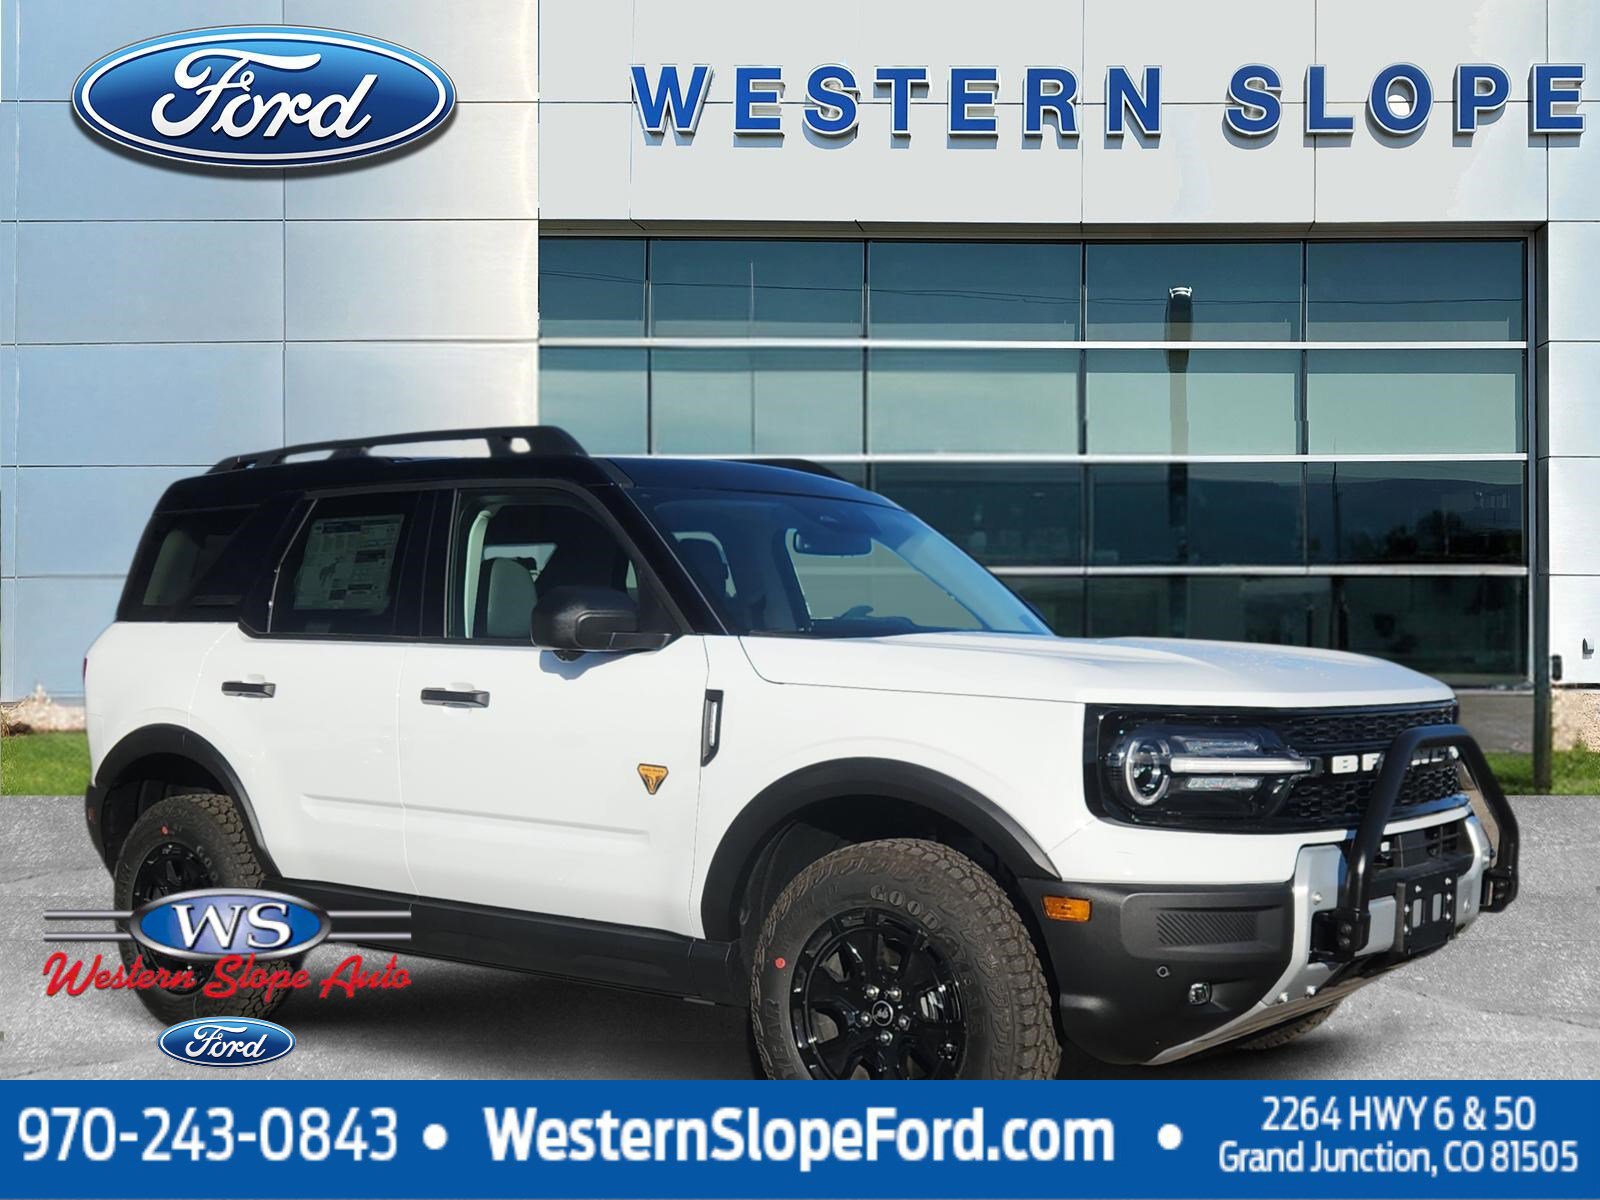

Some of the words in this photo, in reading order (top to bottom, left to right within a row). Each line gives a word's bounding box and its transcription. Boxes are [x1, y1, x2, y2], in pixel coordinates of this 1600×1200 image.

[151, 48, 378, 139] Ford
[629, 64, 1163, 137] WESTERN
[1226, 63, 1587, 135] SLOPE
